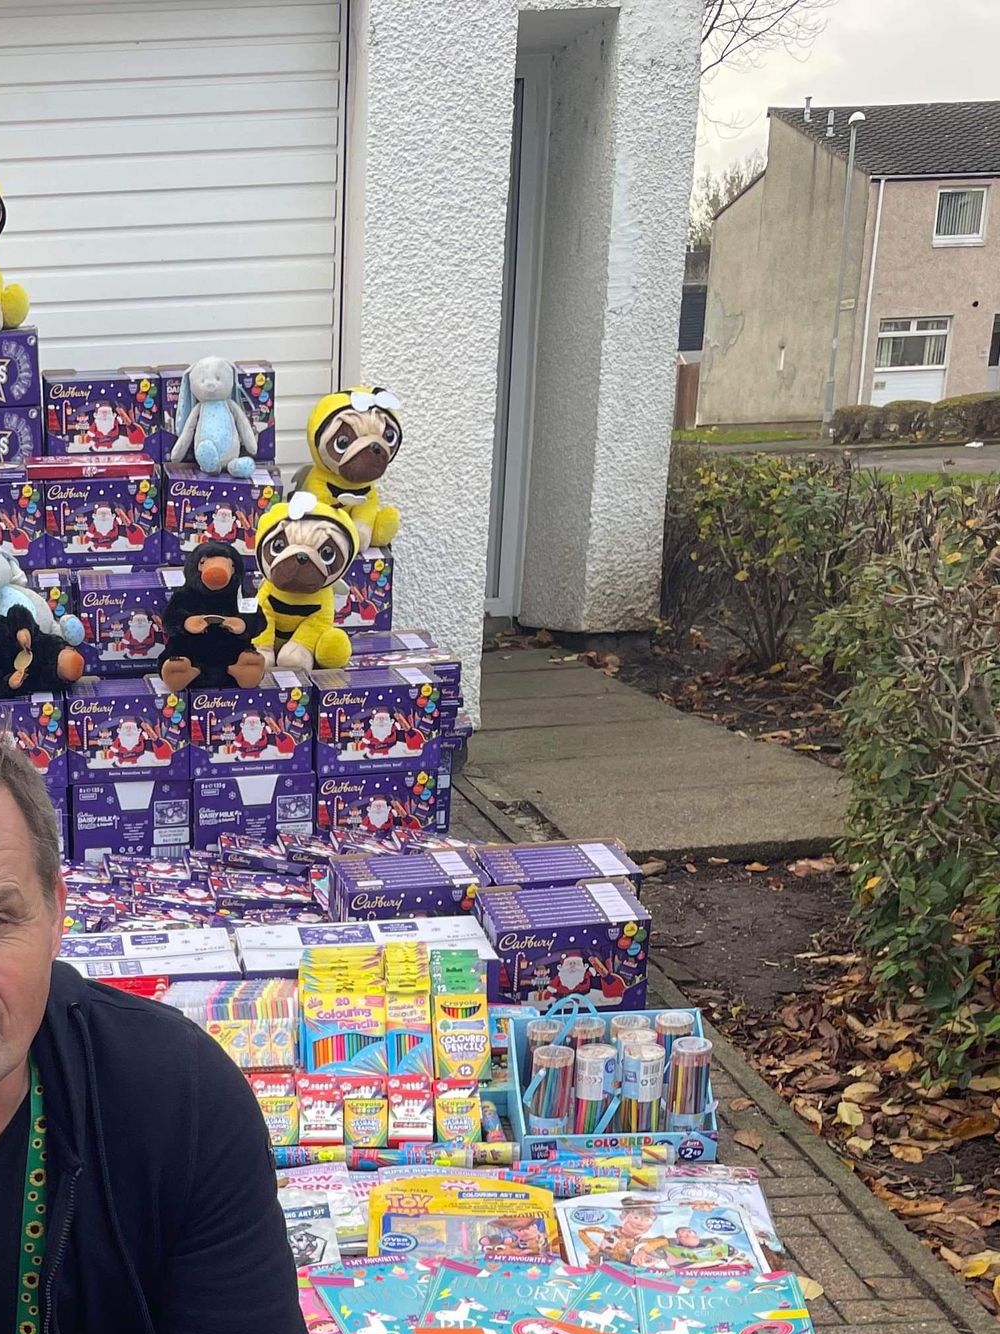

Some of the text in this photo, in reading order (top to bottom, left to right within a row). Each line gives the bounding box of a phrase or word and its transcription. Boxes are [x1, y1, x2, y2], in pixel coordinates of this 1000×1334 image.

[50, 385, 90, 400] Cadbury
[47, 485, 89, 500] Cadbury
[170, 482, 213, 499] Cadbury
[83, 592, 126, 608] Cadbury
[194, 694, 237, 710] Cadbury
[323, 691, 367, 707] Cadbury
[70, 700, 113, 715] Cadbury
[321, 779, 364, 795] Cadbury
[351, 893, 403, 910] Cadbury
[499, 932, 554, 951] Cadbury
[336, 997, 350, 1006] 20
[317, 1007, 371, 1019] Colouring
[339, 1019, 379, 1030] Pencils
[440, 1034, 487, 1045] COLOURED
[445, 1042, 485, 1053] PENCILS
[461, 1067, 472, 1075] 12
[585, 1136, 654, 1149] COLOURED
[384, 1167, 447, 1175] SUPER BUMPER
[386, 1193, 433, 1208] TOY
[313, 1208, 325, 1216] KIT
[351, 1255, 401, 1266] MY FAVOURITE
[508, 1255, 546, 1264] FAVOURITE
